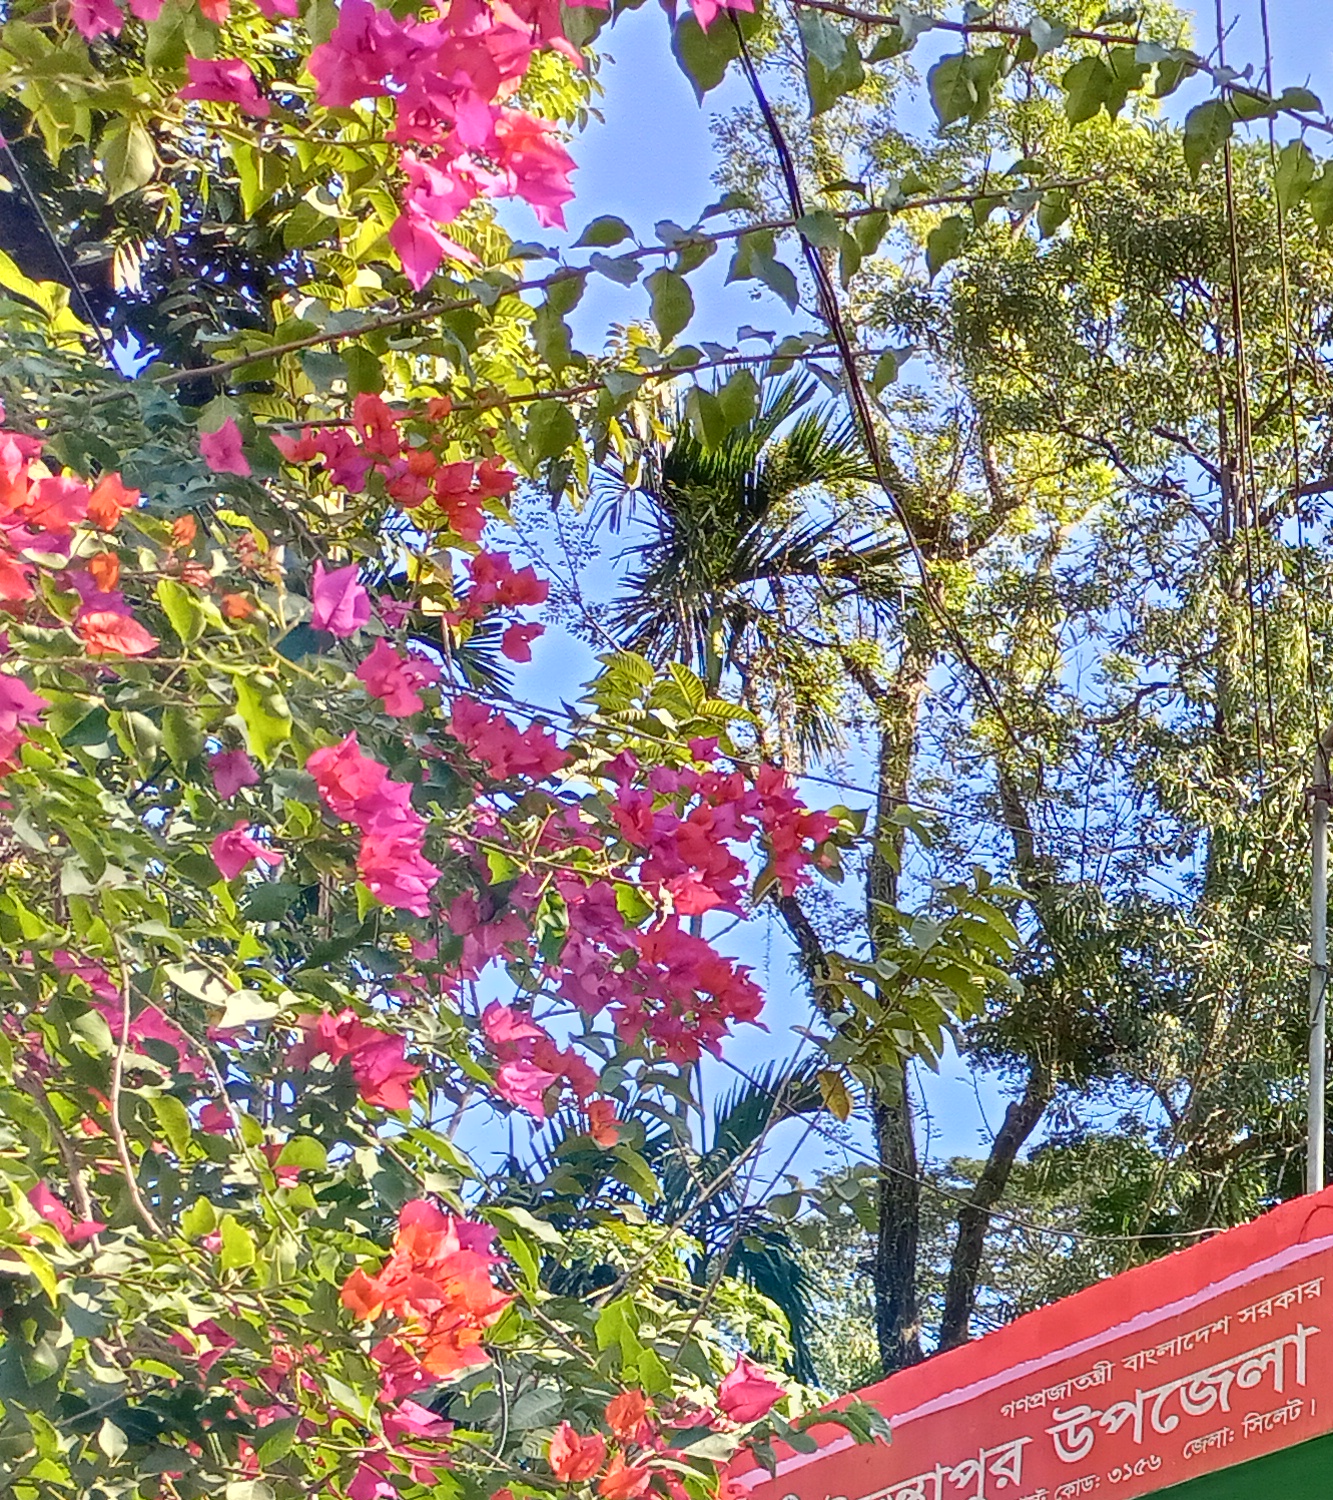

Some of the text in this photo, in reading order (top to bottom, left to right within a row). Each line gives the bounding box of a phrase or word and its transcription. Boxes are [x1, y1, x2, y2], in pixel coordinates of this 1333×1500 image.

[1122, 1314, 1233, 1372] বাংলাদেশ
[1237, 1276, 1325, 1324] সরকার
[1045, 1322, 1321, 1463] উপজেলা
[1106, 1454, 1163, 1484] ৩১৫৬
